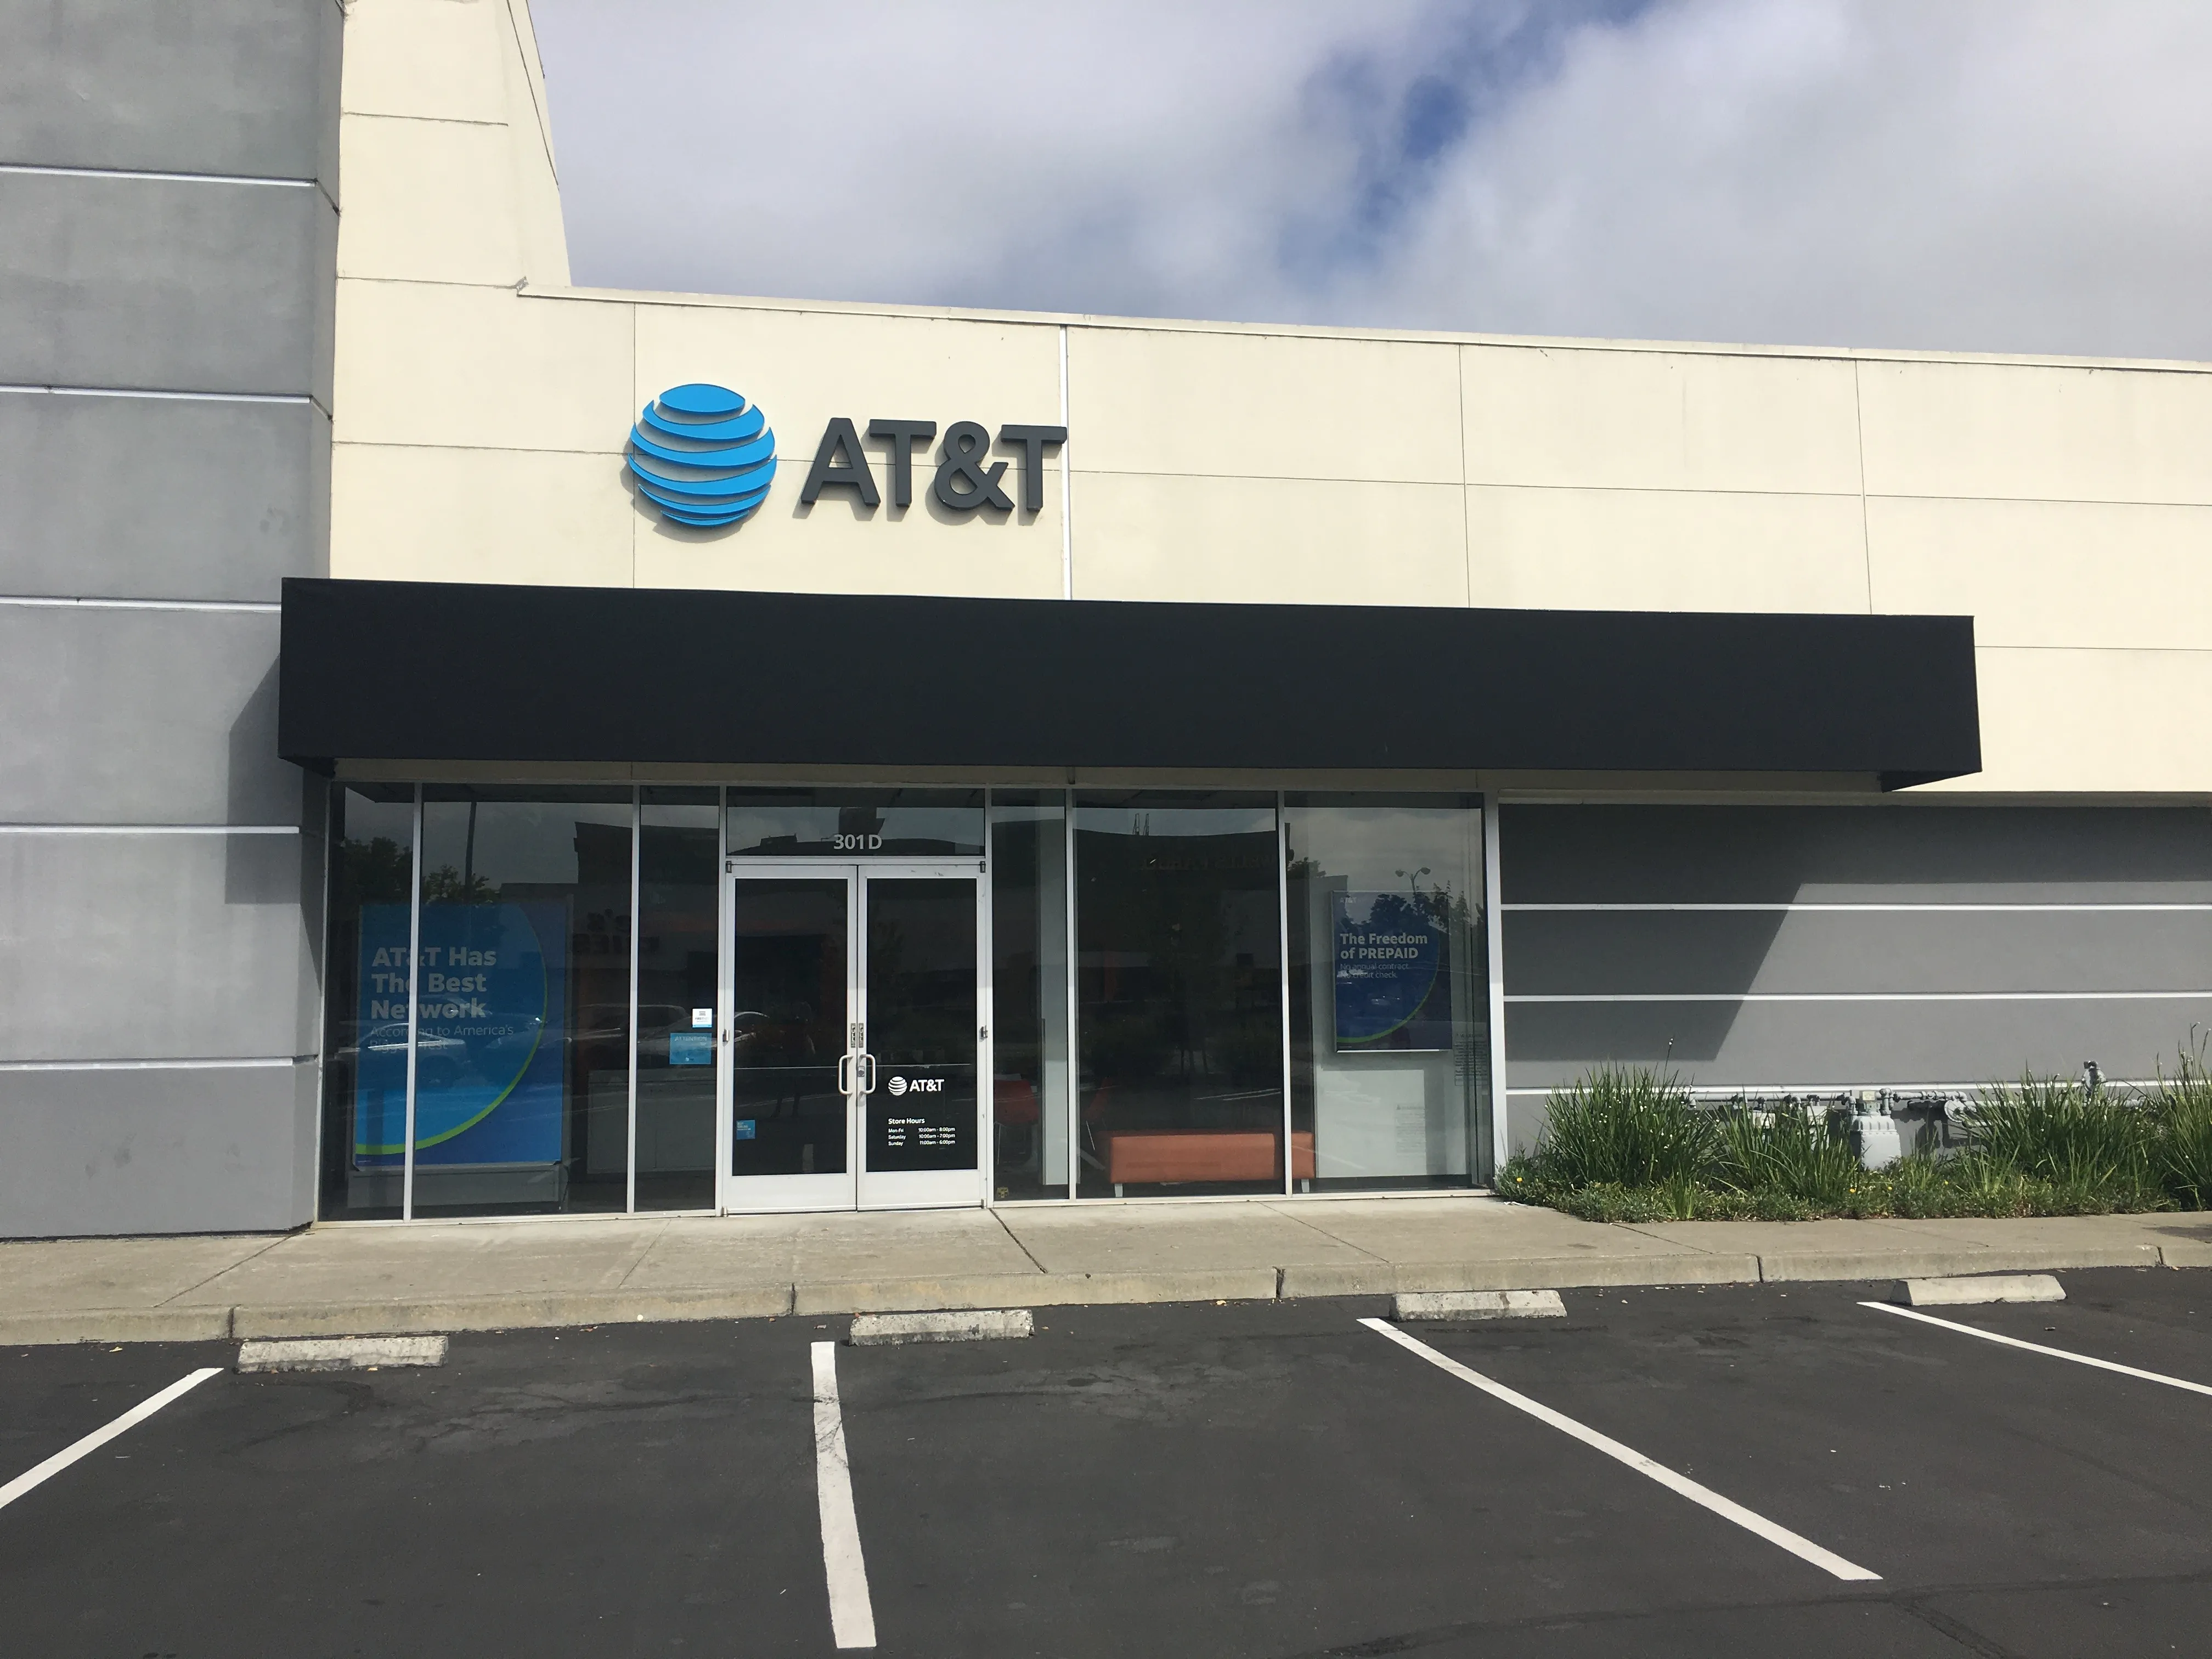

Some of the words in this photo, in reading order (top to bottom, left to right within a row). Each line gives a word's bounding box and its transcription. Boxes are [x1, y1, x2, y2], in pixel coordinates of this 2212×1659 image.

[801, 417, 1067, 511] AT&T
[1340, 933, 1365, 945] The
[1369, 933, 1427, 944] Freedom
[449, 946, 496, 966] Has
[1340, 947, 1355, 959] of
[1359, 947, 1418, 959] PREPAID
[428, 973, 487, 992] Best
[371, 997, 487, 1019] Nework
[437, 1026, 450, 1036] to
[454, 1025, 514, 1036] America's
[909, 1079, 945, 1092] AT&T
